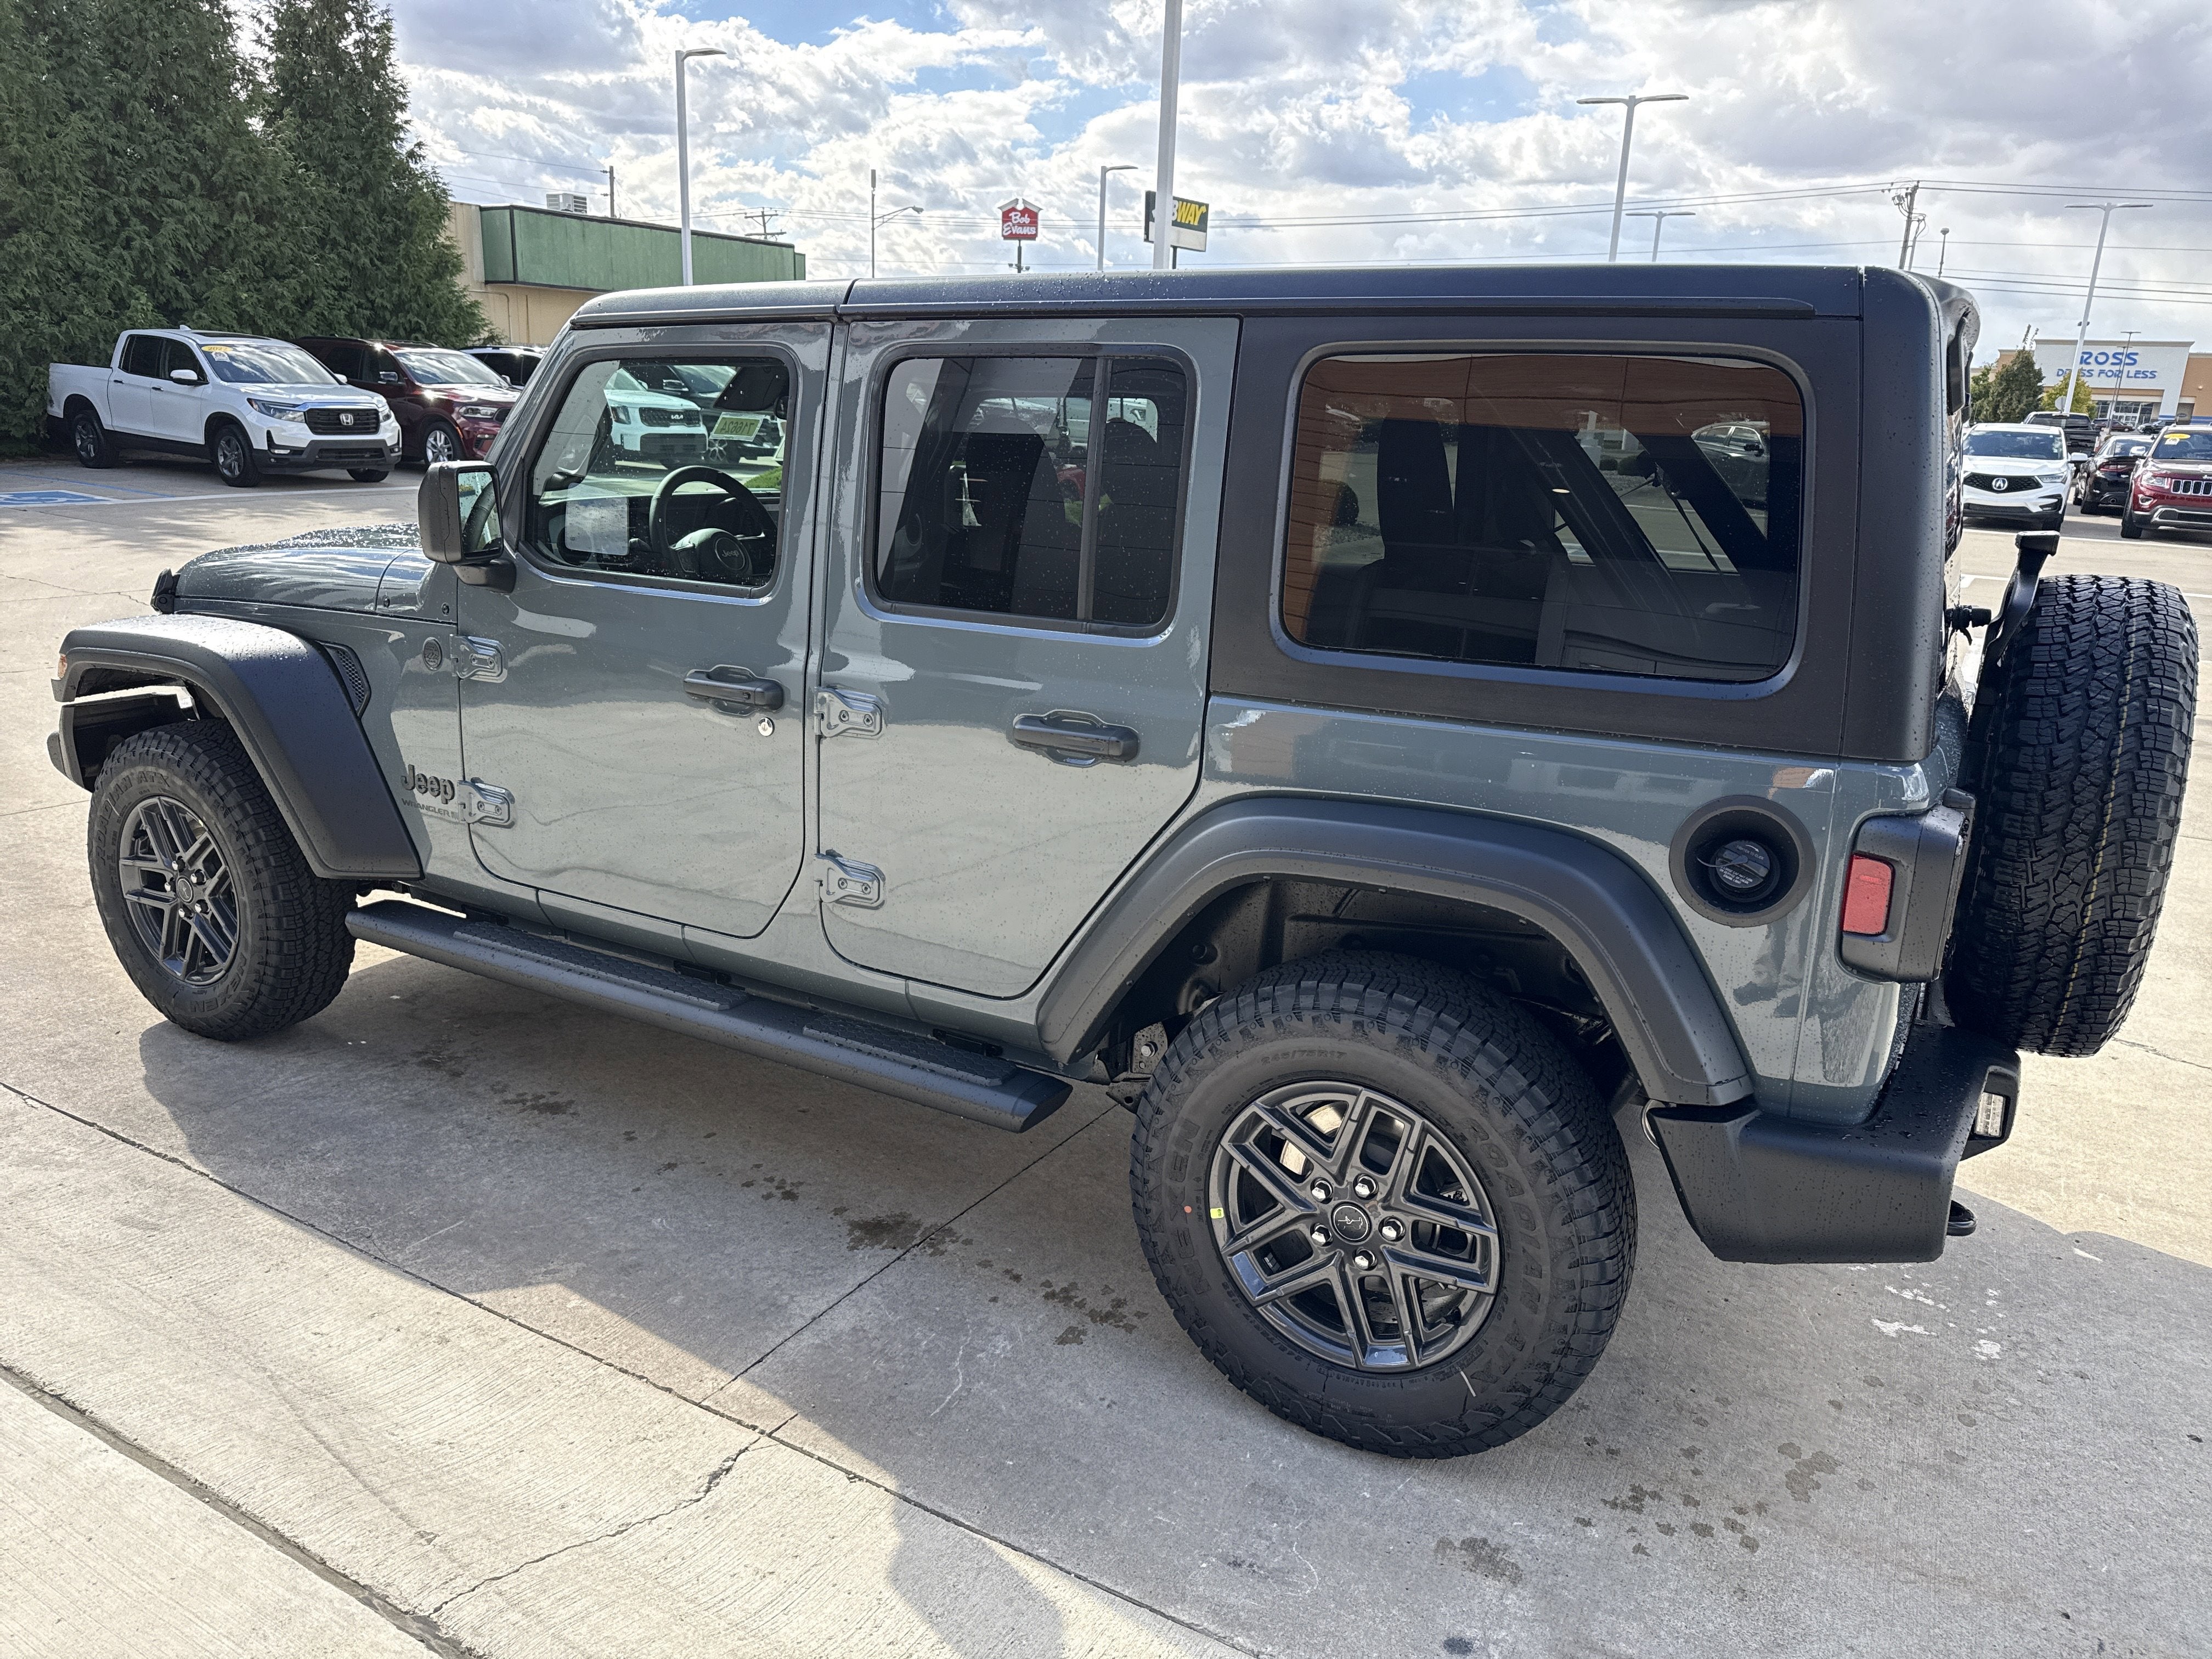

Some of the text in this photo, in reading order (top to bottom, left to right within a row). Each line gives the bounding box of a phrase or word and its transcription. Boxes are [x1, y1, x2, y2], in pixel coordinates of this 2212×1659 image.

[1009, 212, 1030, 224] Bob
[1152, 200, 1206, 225] BWAY
[1003, 222, 1036, 236] Evans
[2080, 351, 2139, 366] ROSS
[2057, 368, 2158, 379] DSS FOR LESS
[400, 764, 456, 805] Jeep
[401, 798, 451, 817] WRANGLER
[95, 770, 171, 866] ROADIAN ATX
